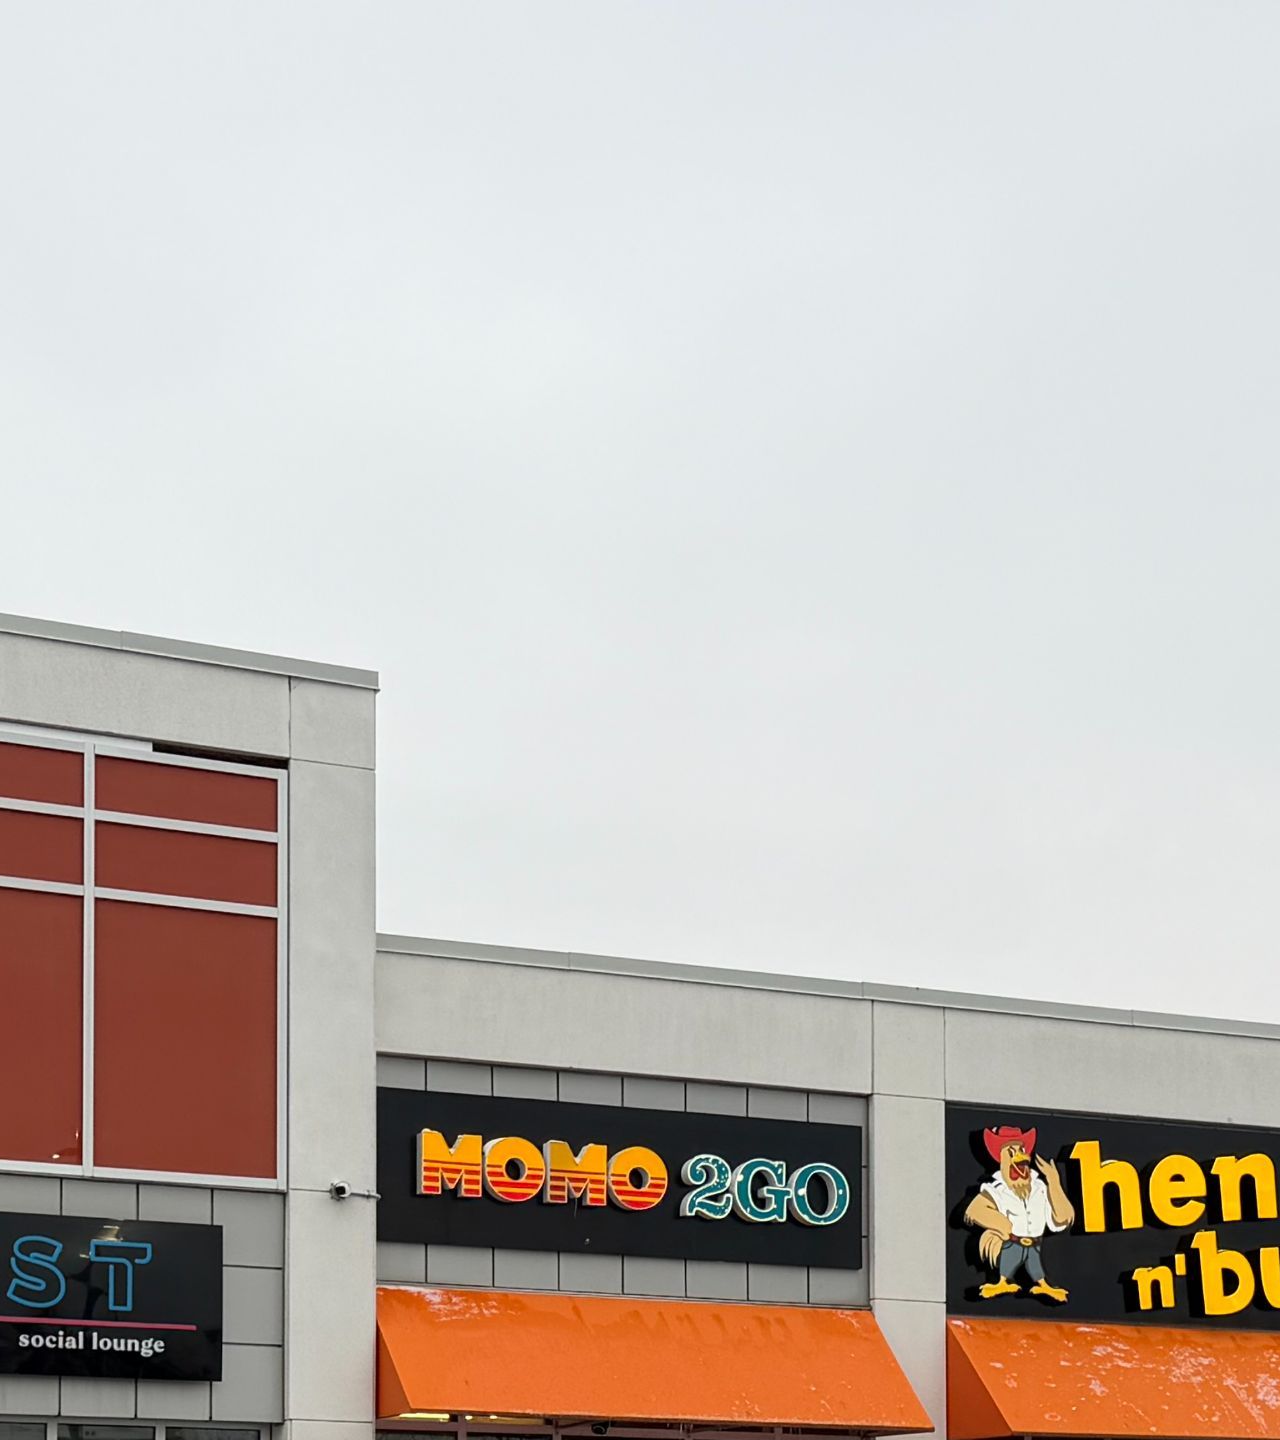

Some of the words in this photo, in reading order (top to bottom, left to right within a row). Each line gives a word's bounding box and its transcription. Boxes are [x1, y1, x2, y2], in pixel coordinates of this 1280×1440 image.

[416, 1128, 669, 1211] MOMO
[680, 1153, 851, 1226] 2GO
[1070, 1140, 1278, 1233] hen
[19, 1330, 84, 1350] social
[92, 1331, 165, 1357] lounge
